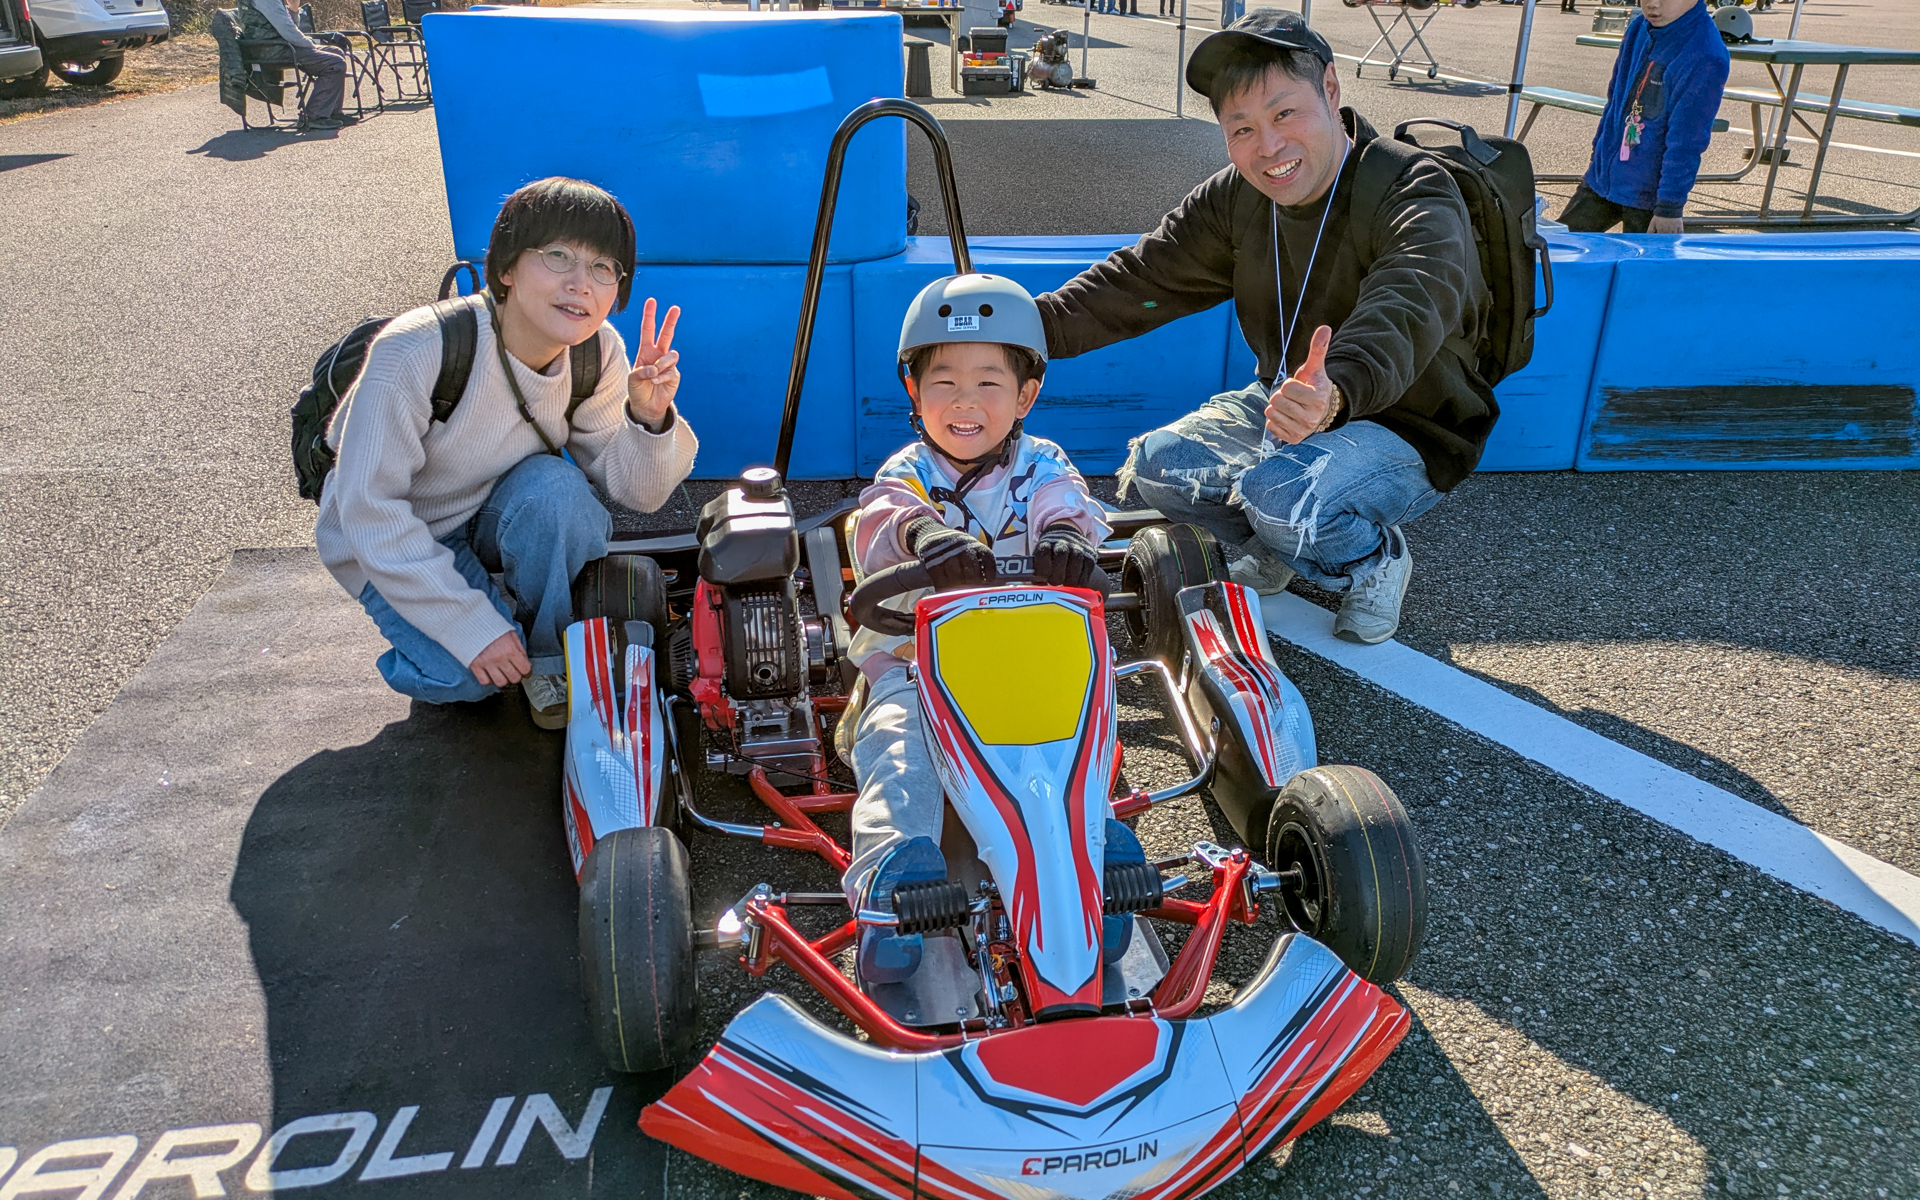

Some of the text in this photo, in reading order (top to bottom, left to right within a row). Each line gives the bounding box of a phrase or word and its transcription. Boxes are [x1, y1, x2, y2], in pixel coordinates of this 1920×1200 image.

[954, 316, 973, 327] BEAR
[988, 593, 1044, 605] PAROLIN
[0, 1086, 613, 1200] AROLIN
[1043, 1139, 1158, 1175] PAROLIN
